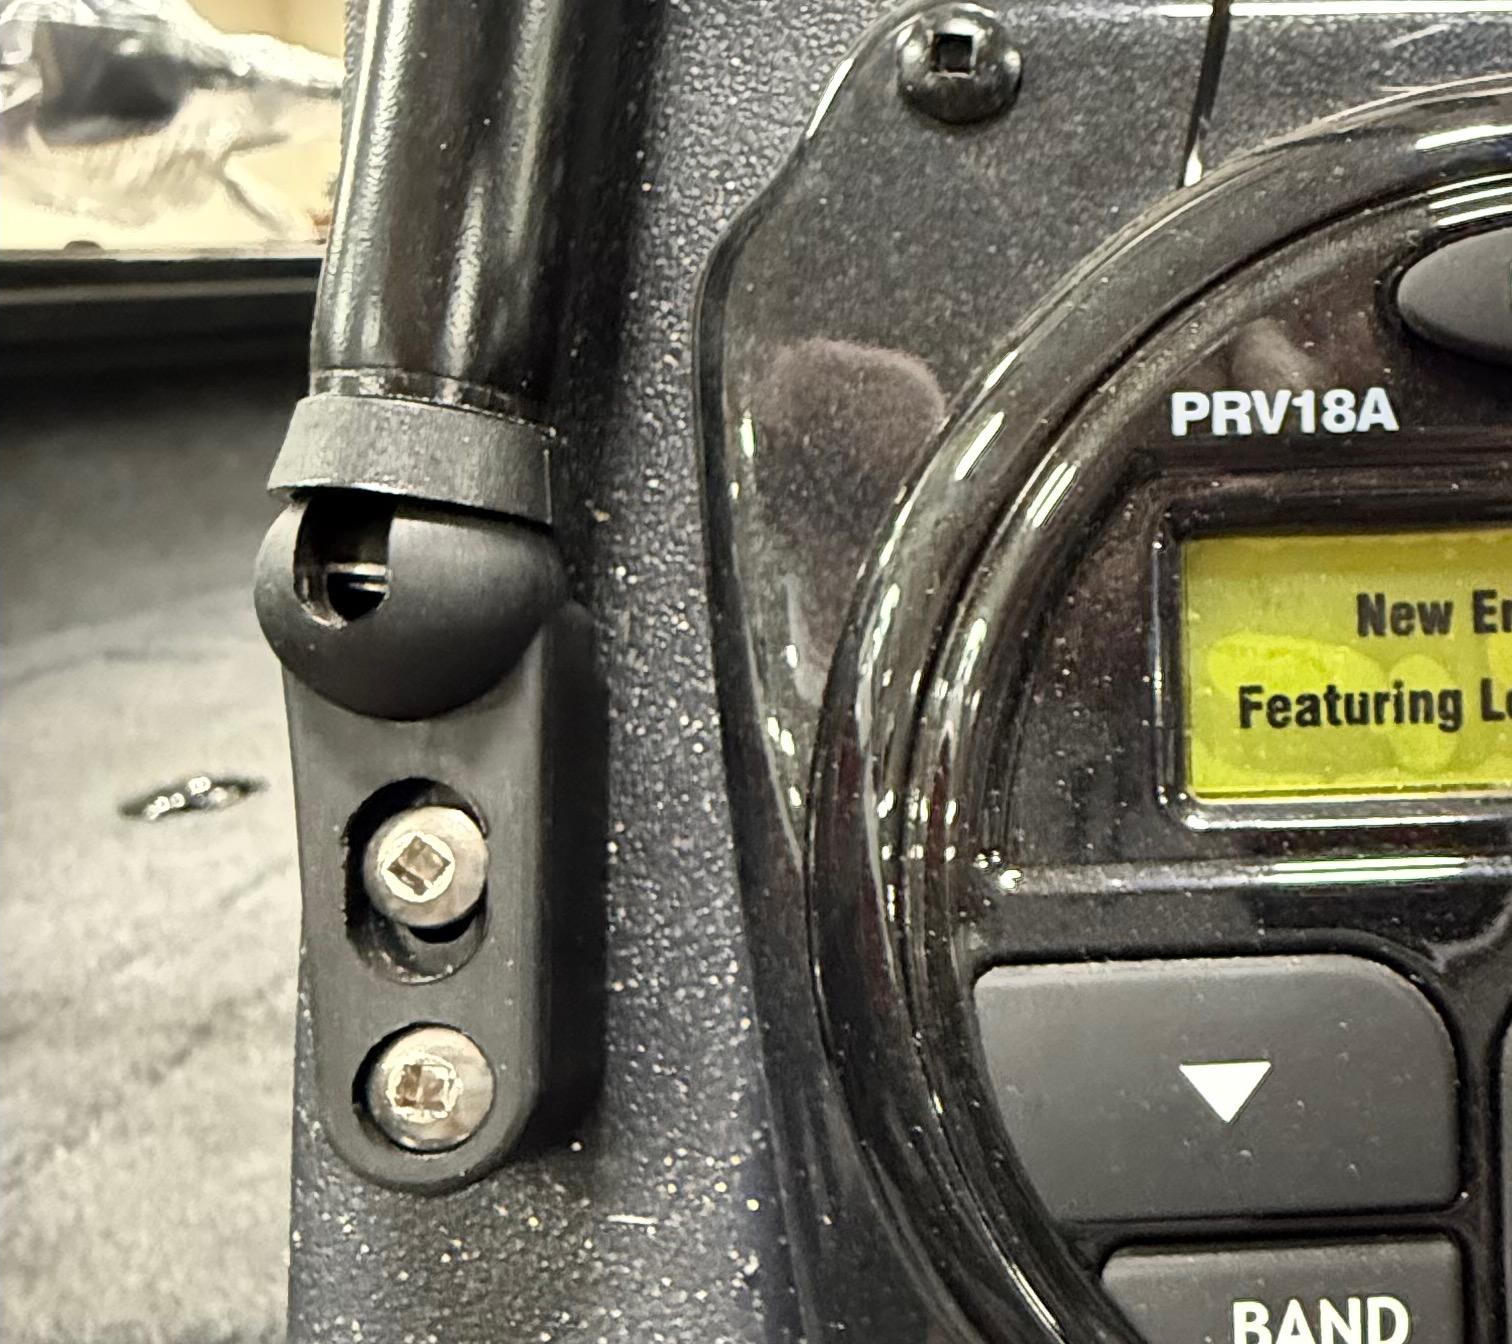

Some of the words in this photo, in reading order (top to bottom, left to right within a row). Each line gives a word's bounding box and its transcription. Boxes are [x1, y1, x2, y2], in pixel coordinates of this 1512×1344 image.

[1170, 389, 1399, 436] PRV18A
[1356, 593, 1452, 638] New
[1238, 682, 1463, 733] Featuring
